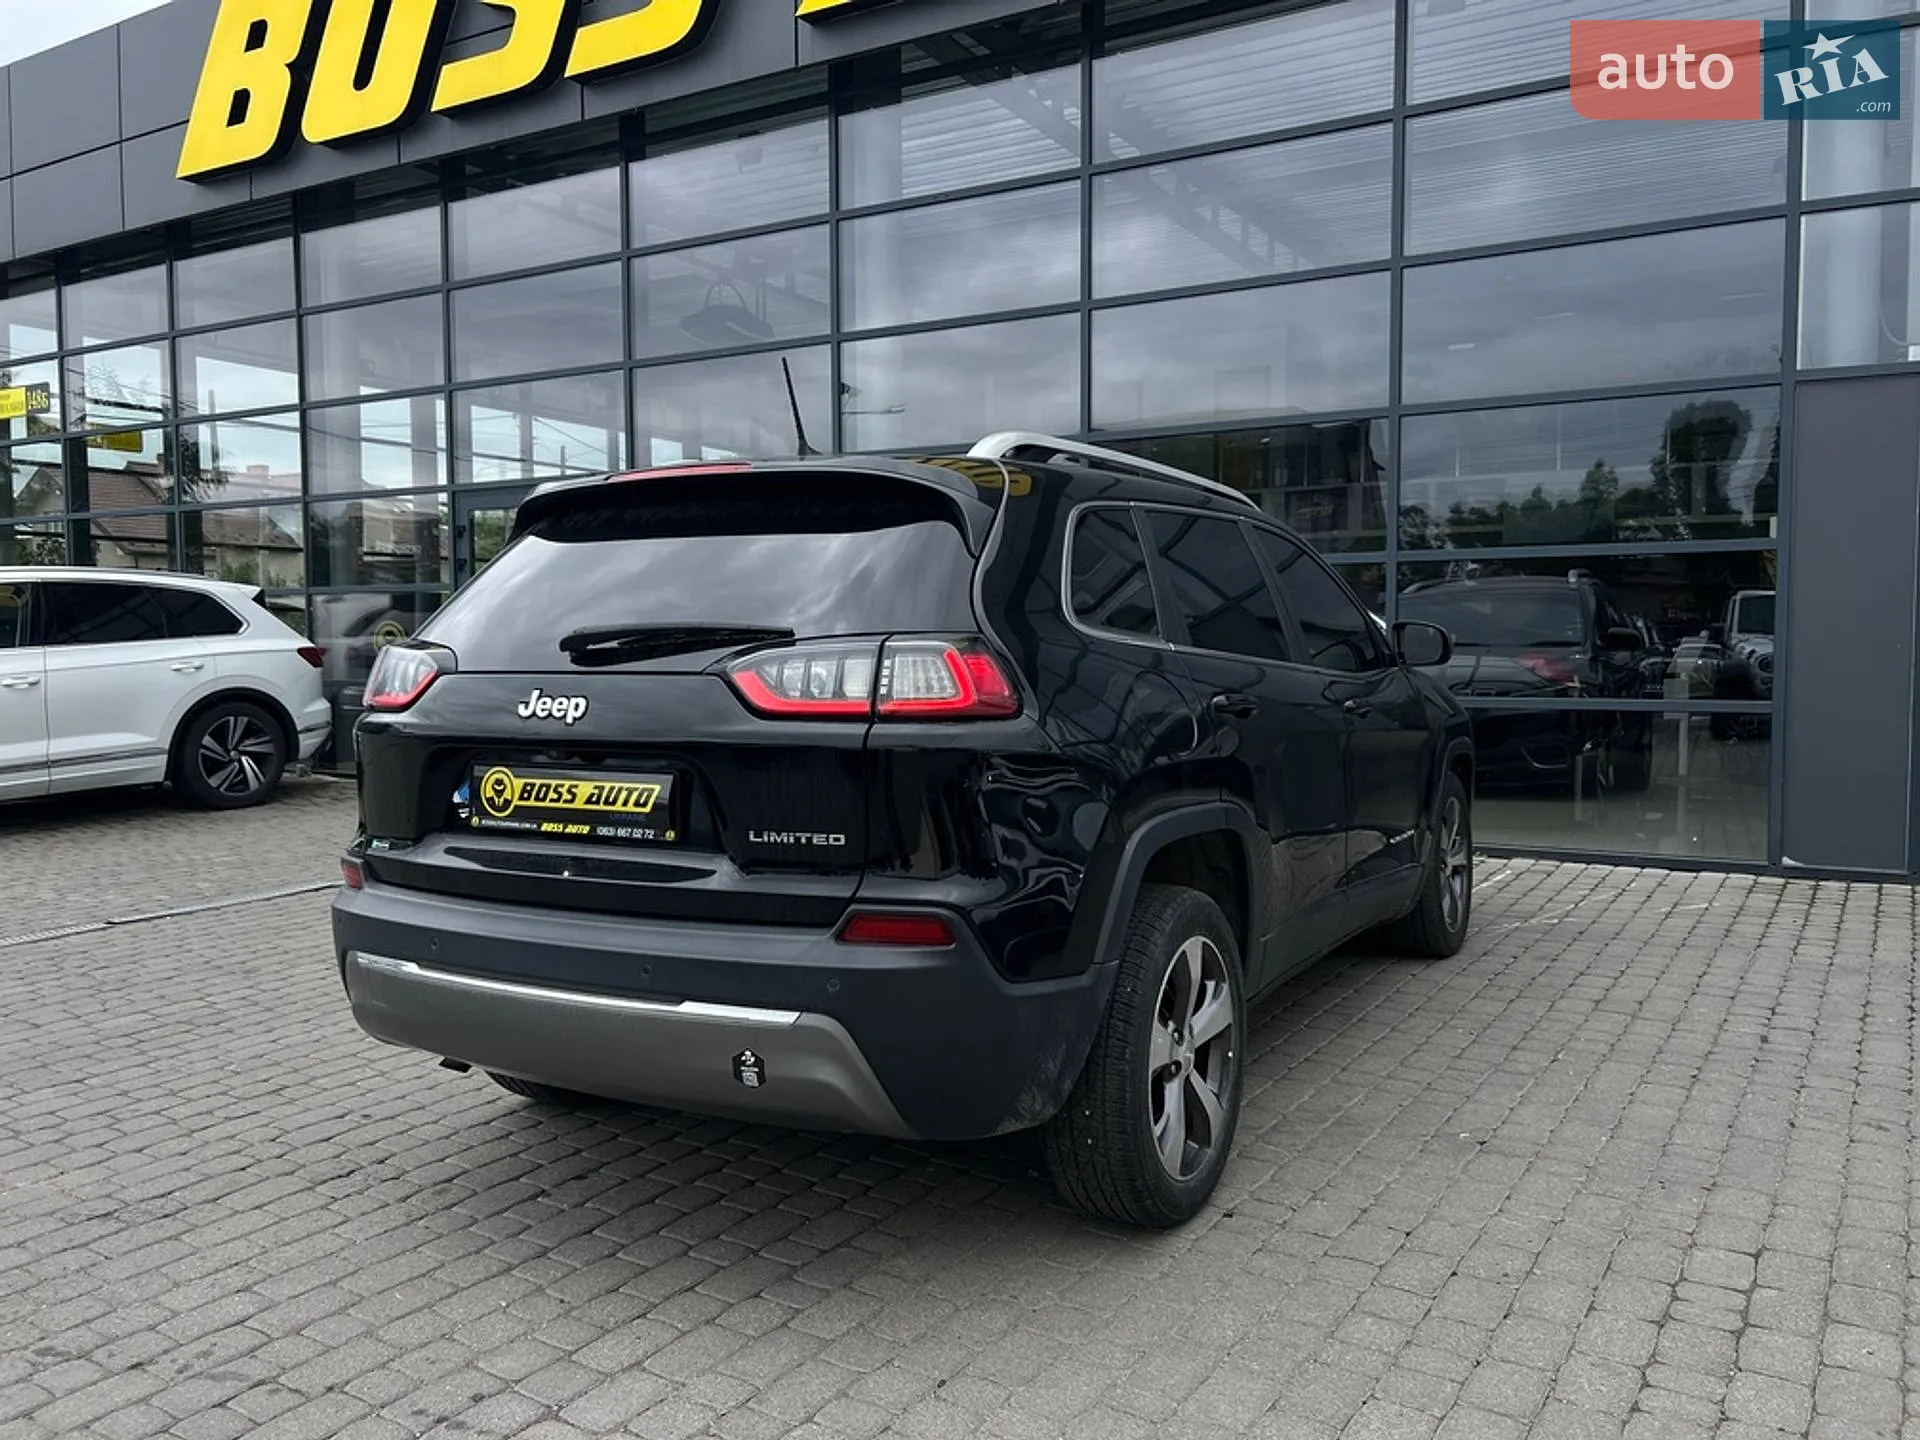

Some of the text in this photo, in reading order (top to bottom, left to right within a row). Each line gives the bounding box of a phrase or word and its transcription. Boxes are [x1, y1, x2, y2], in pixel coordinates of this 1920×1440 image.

[517, 689, 588, 724] Jeep
[518, 781, 657, 808] BOSS AUTO
[540, 822, 565, 832] BOSS
[564, 824, 591, 834] AUTO
[748, 830, 846, 845] LIMITED
